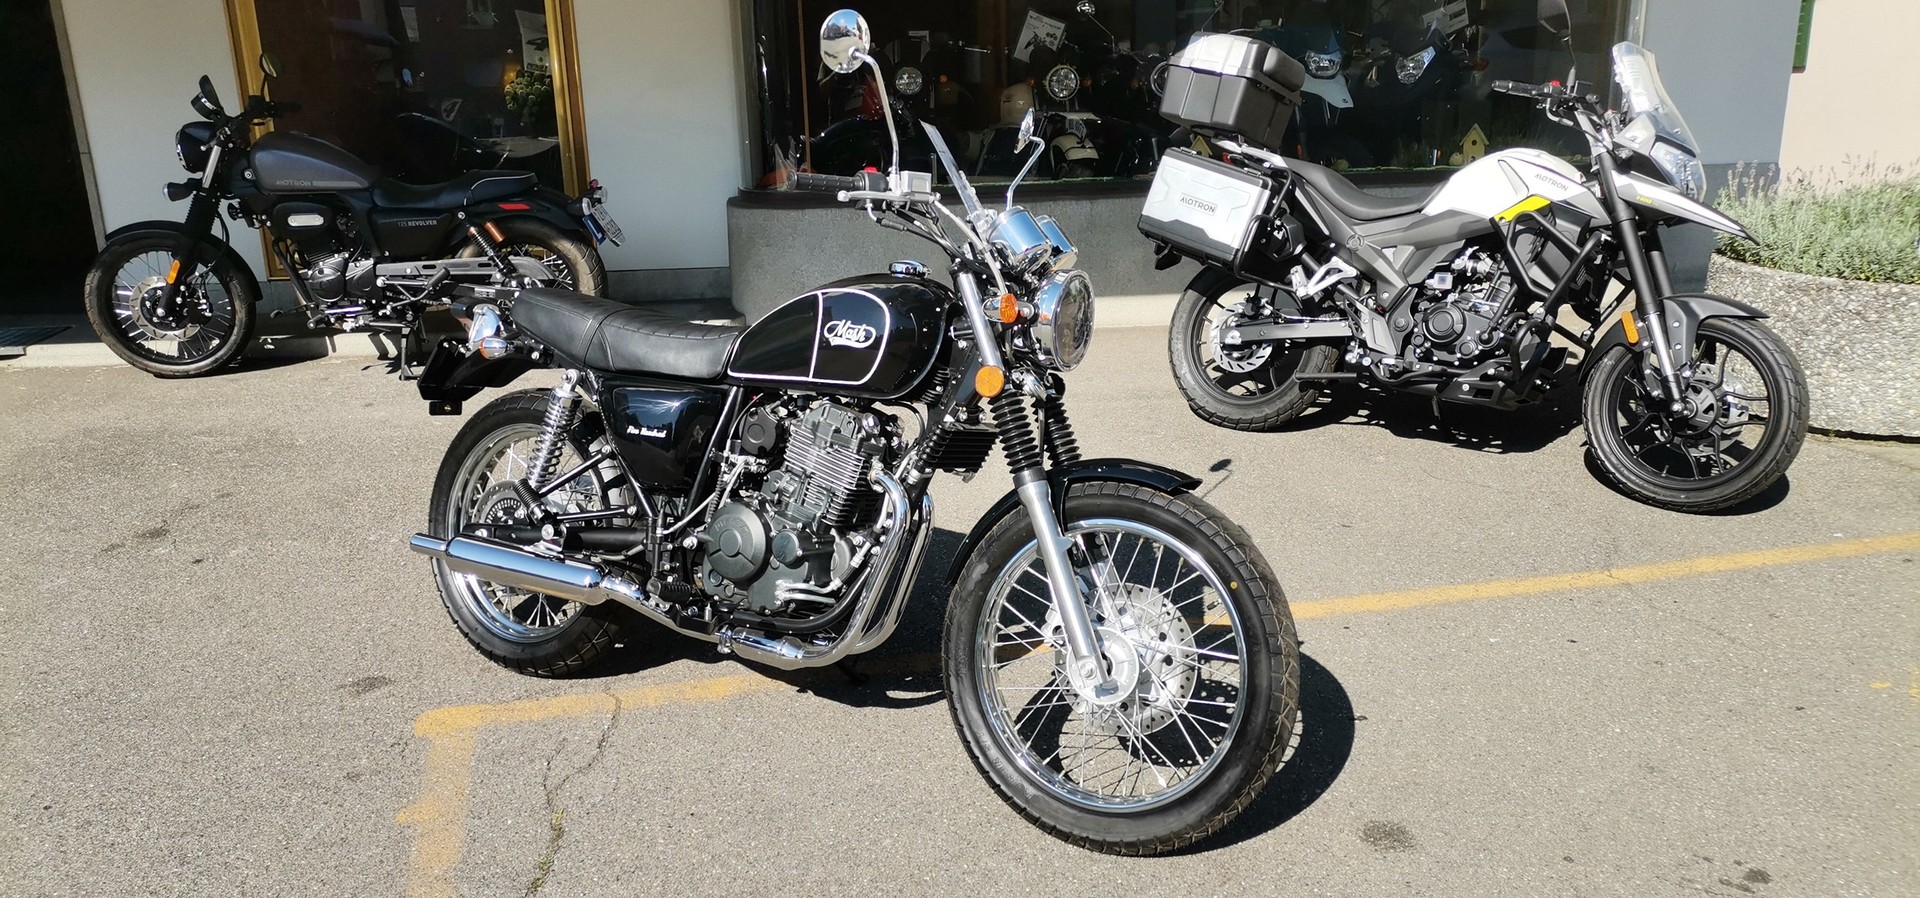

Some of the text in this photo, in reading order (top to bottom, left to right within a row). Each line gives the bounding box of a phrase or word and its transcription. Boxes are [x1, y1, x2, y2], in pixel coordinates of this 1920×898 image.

[1534, 172, 1569, 192] MOTRON
[1179, 195, 1216, 214] MOTRON
[407, 219, 438, 227] REVOLVER
[824, 319, 871, 345] Mash
